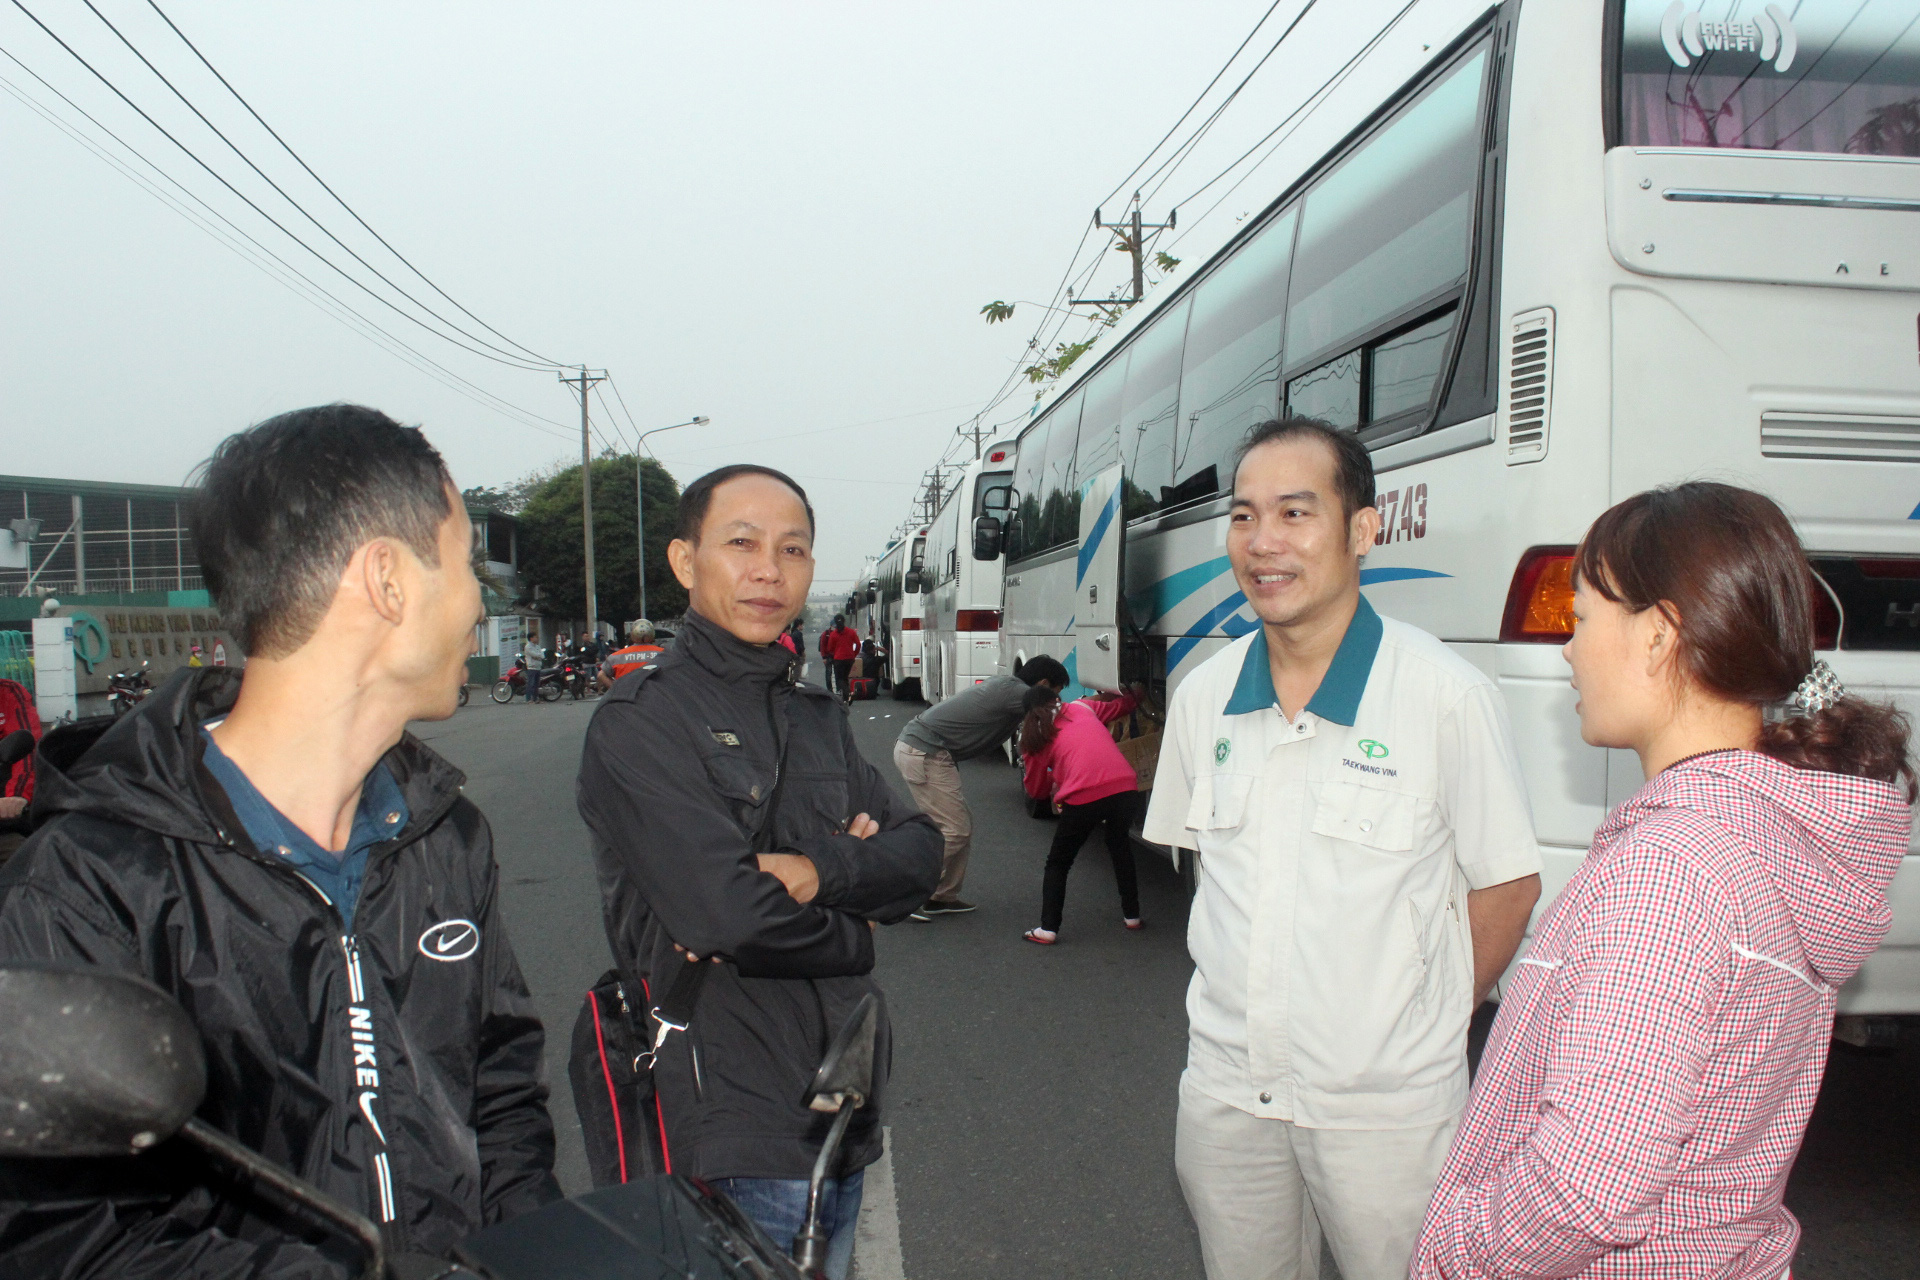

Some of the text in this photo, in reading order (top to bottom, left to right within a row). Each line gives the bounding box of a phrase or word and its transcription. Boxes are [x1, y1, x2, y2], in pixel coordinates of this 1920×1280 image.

[1701, 21, 1756, 37] FREE
[1702, 35, 1756, 52] Wi-Fi
[1342, 757, 1398, 778] TAEKWANG VINA
[348, 1006, 380, 1088] NIKE
